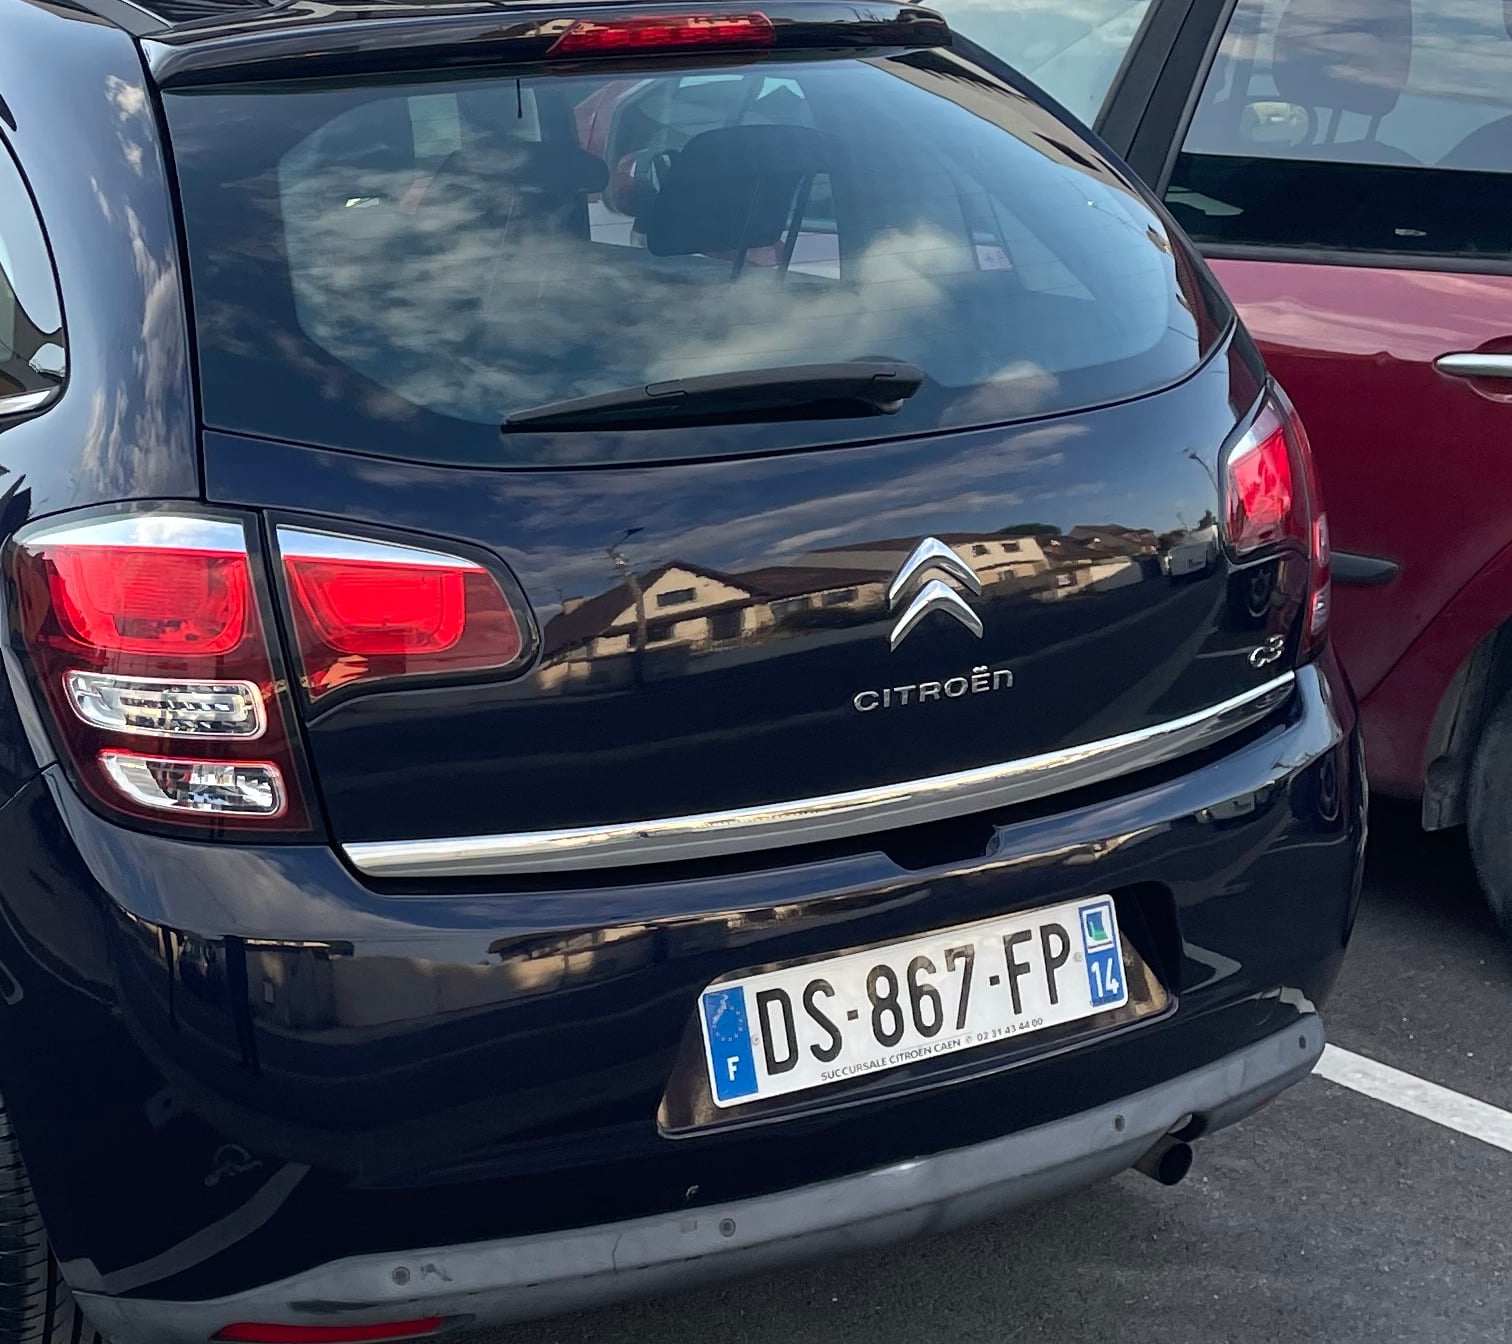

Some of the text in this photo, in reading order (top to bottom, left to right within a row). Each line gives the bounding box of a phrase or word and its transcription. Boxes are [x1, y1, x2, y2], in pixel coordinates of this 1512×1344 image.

[1250, 634, 1284, 668] C3
[1090, 957, 1120, 998] 14
[756, 922, 1071, 1076] DS-867-FP
[726, 1056, 740, 1081] F
[820, 1057, 888, 1081] SUCCURSALE
[933, 1039, 961, 1053] CAEN
[976, 1032, 989, 1042] 02
